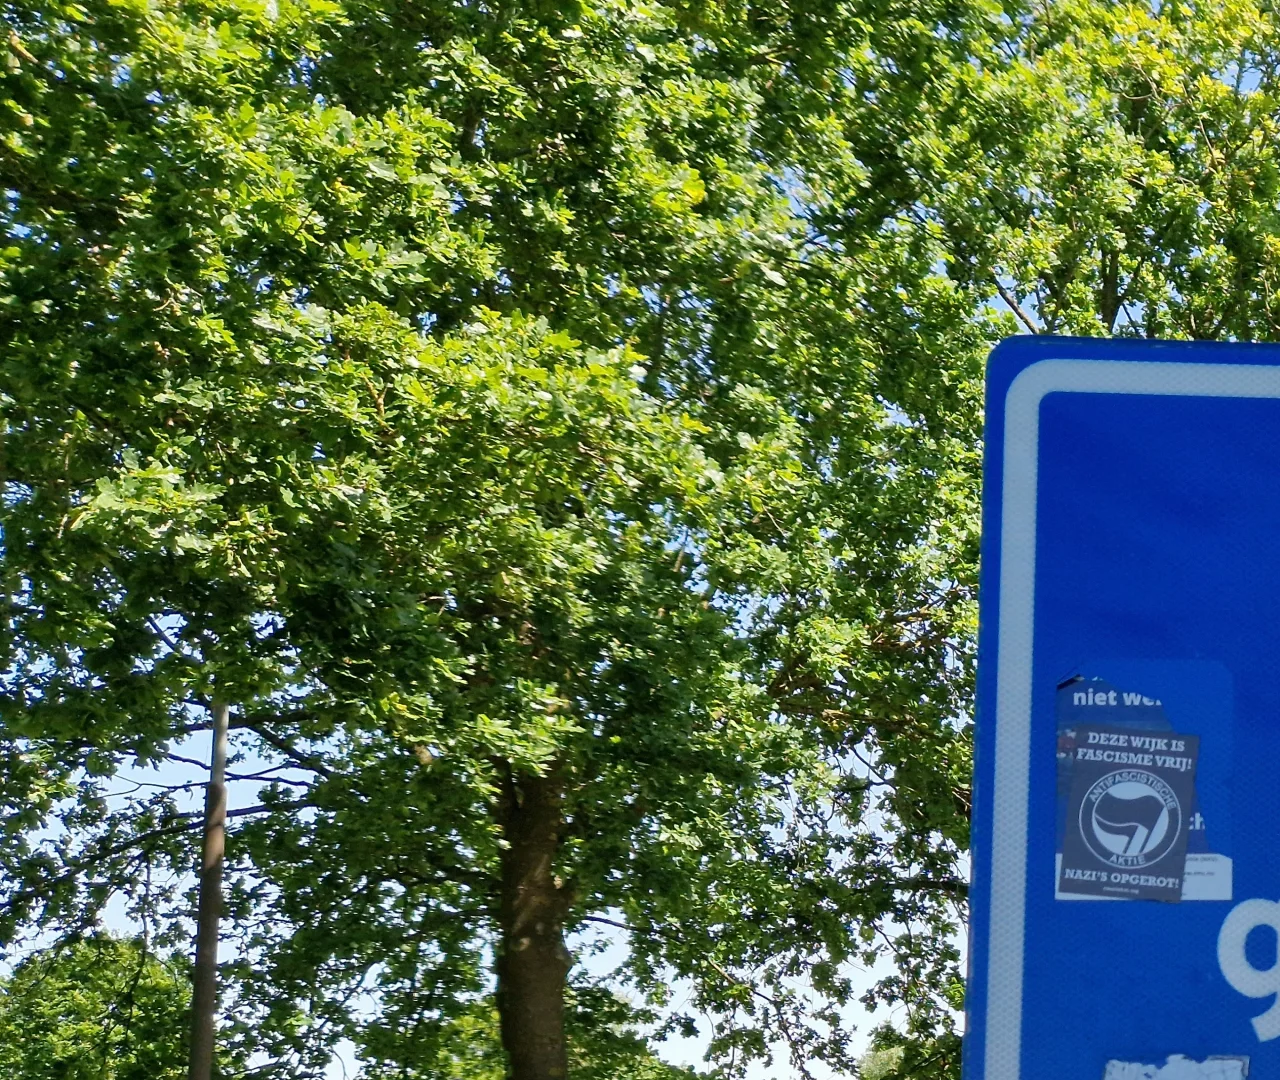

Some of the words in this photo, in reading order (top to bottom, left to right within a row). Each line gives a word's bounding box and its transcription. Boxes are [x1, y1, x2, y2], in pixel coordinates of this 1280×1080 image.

[1073, 688, 1117, 706] niet
[1123, 692, 1162, 706] we
[1088, 732, 1128, 746] DEZE
[1130, 736, 1168, 752] WIJK
[1170, 740, 1185, 752] IS
[1075, 748, 1153, 766] FASCISME
[1155, 755, 1192, 771] VRIJ!
[1089, 772, 1176, 810] ANTIFASCISTISCHE
[1109, 854, 1146, 866] AKTIE
[1065, 869, 1107, 882] NAZI'S
[1110, 872, 1179, 888] OPGEROT!
